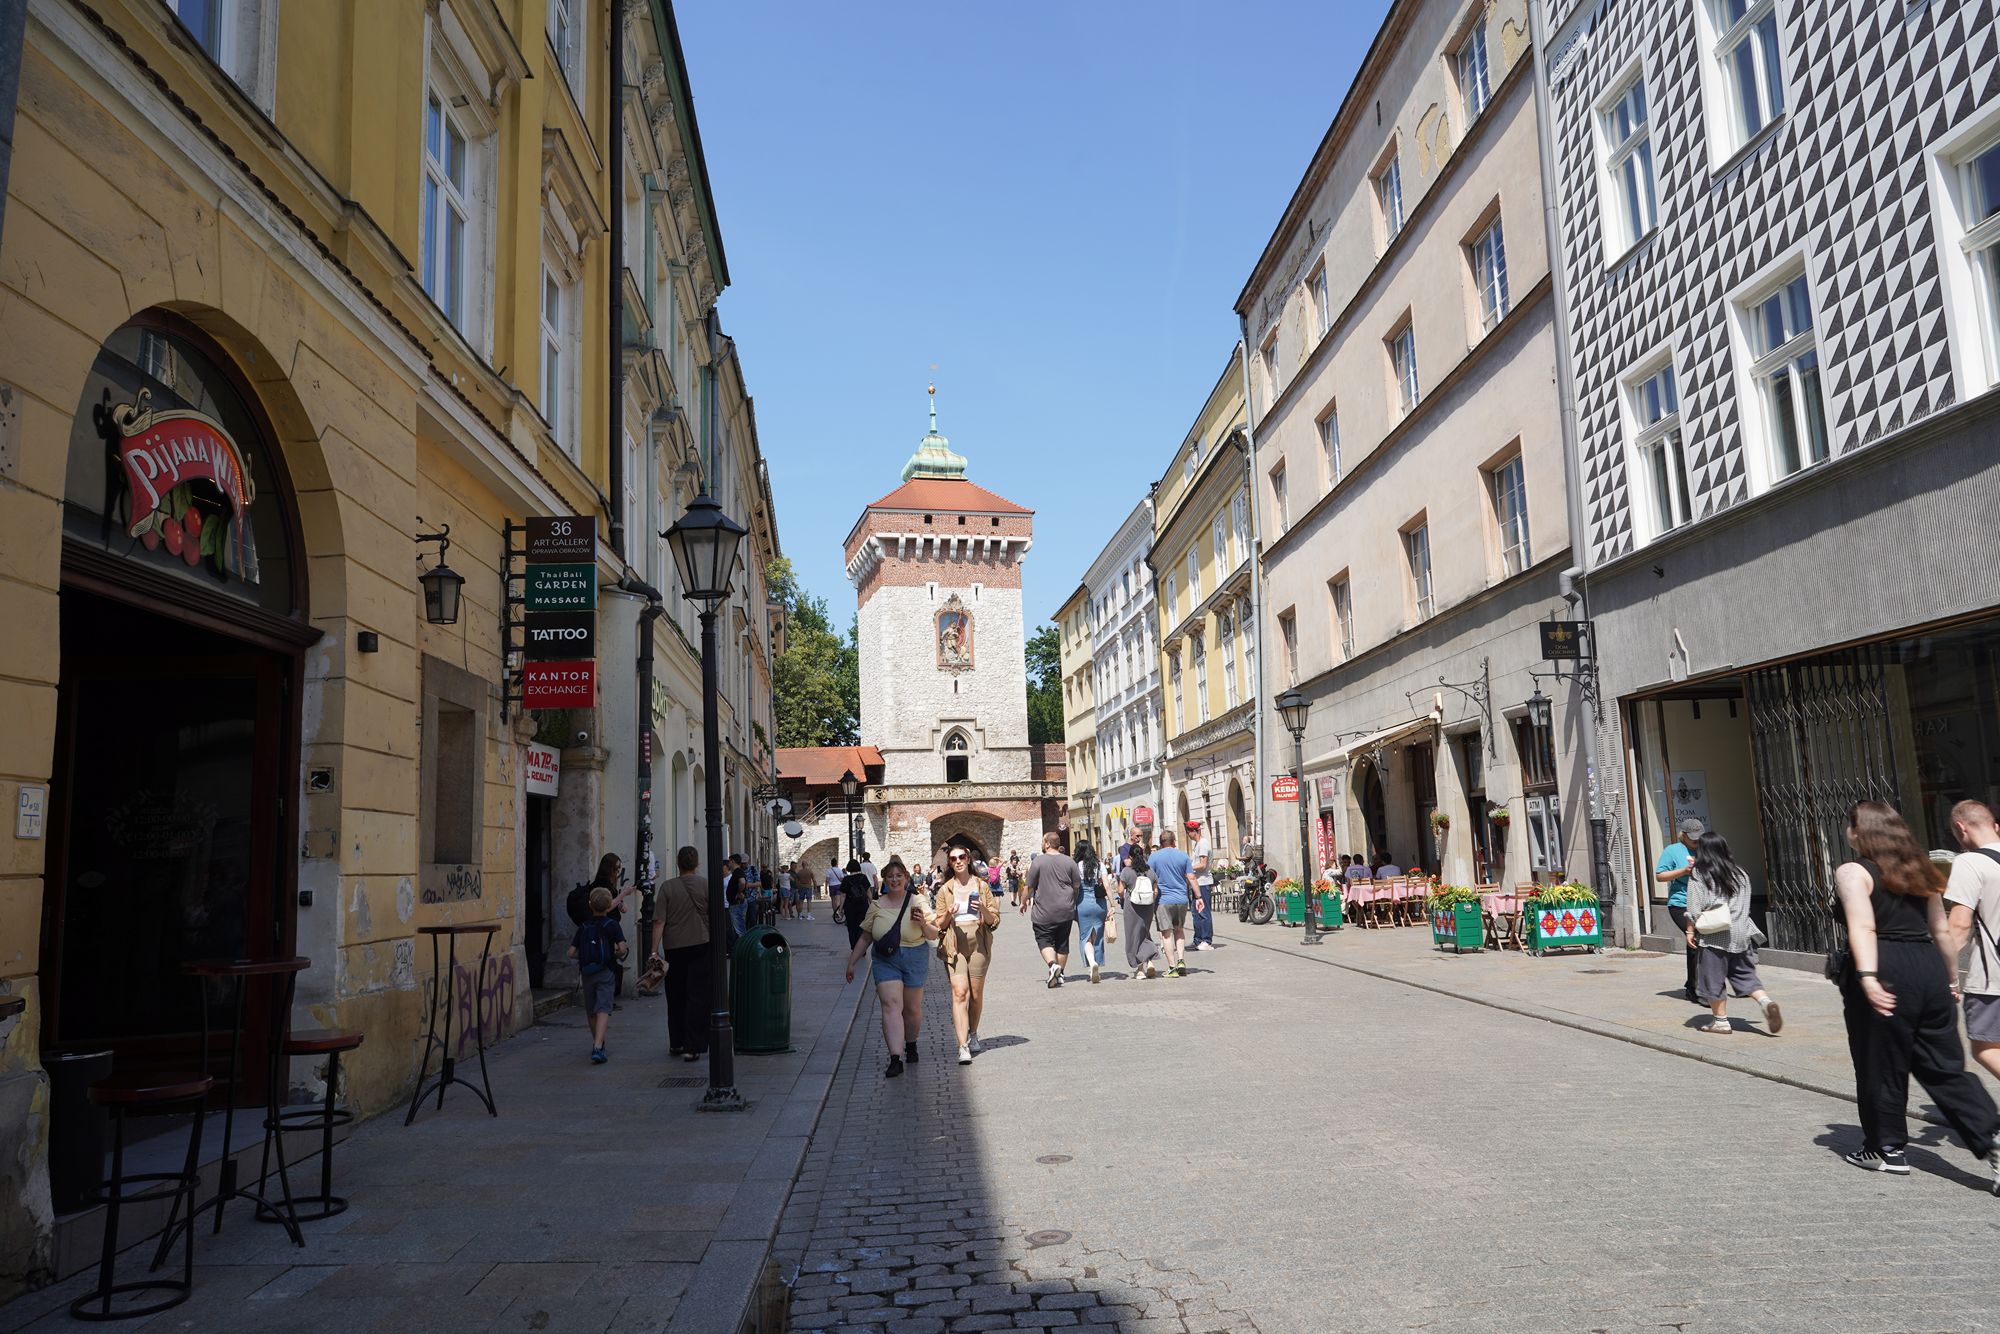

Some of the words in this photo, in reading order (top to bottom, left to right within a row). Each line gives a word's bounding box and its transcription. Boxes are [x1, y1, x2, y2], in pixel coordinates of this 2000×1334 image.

[551, 521, 572, 536] 36
[534, 539, 550, 547] ART
[552, 538, 589, 546] GALLERY
[535, 581, 587, 589] GARDEN
[531, 628, 588, 640] TATTOO
[529, 672, 589, 681] KANTOR
[528, 685, 588, 695] EXCHANGE
[531, 771, 553, 783] REALITY
[1529, 800, 1540, 810] ATM
[1675, 808, 1696, 816] DOM
[1317, 821, 1326, 876] EXCHANG
